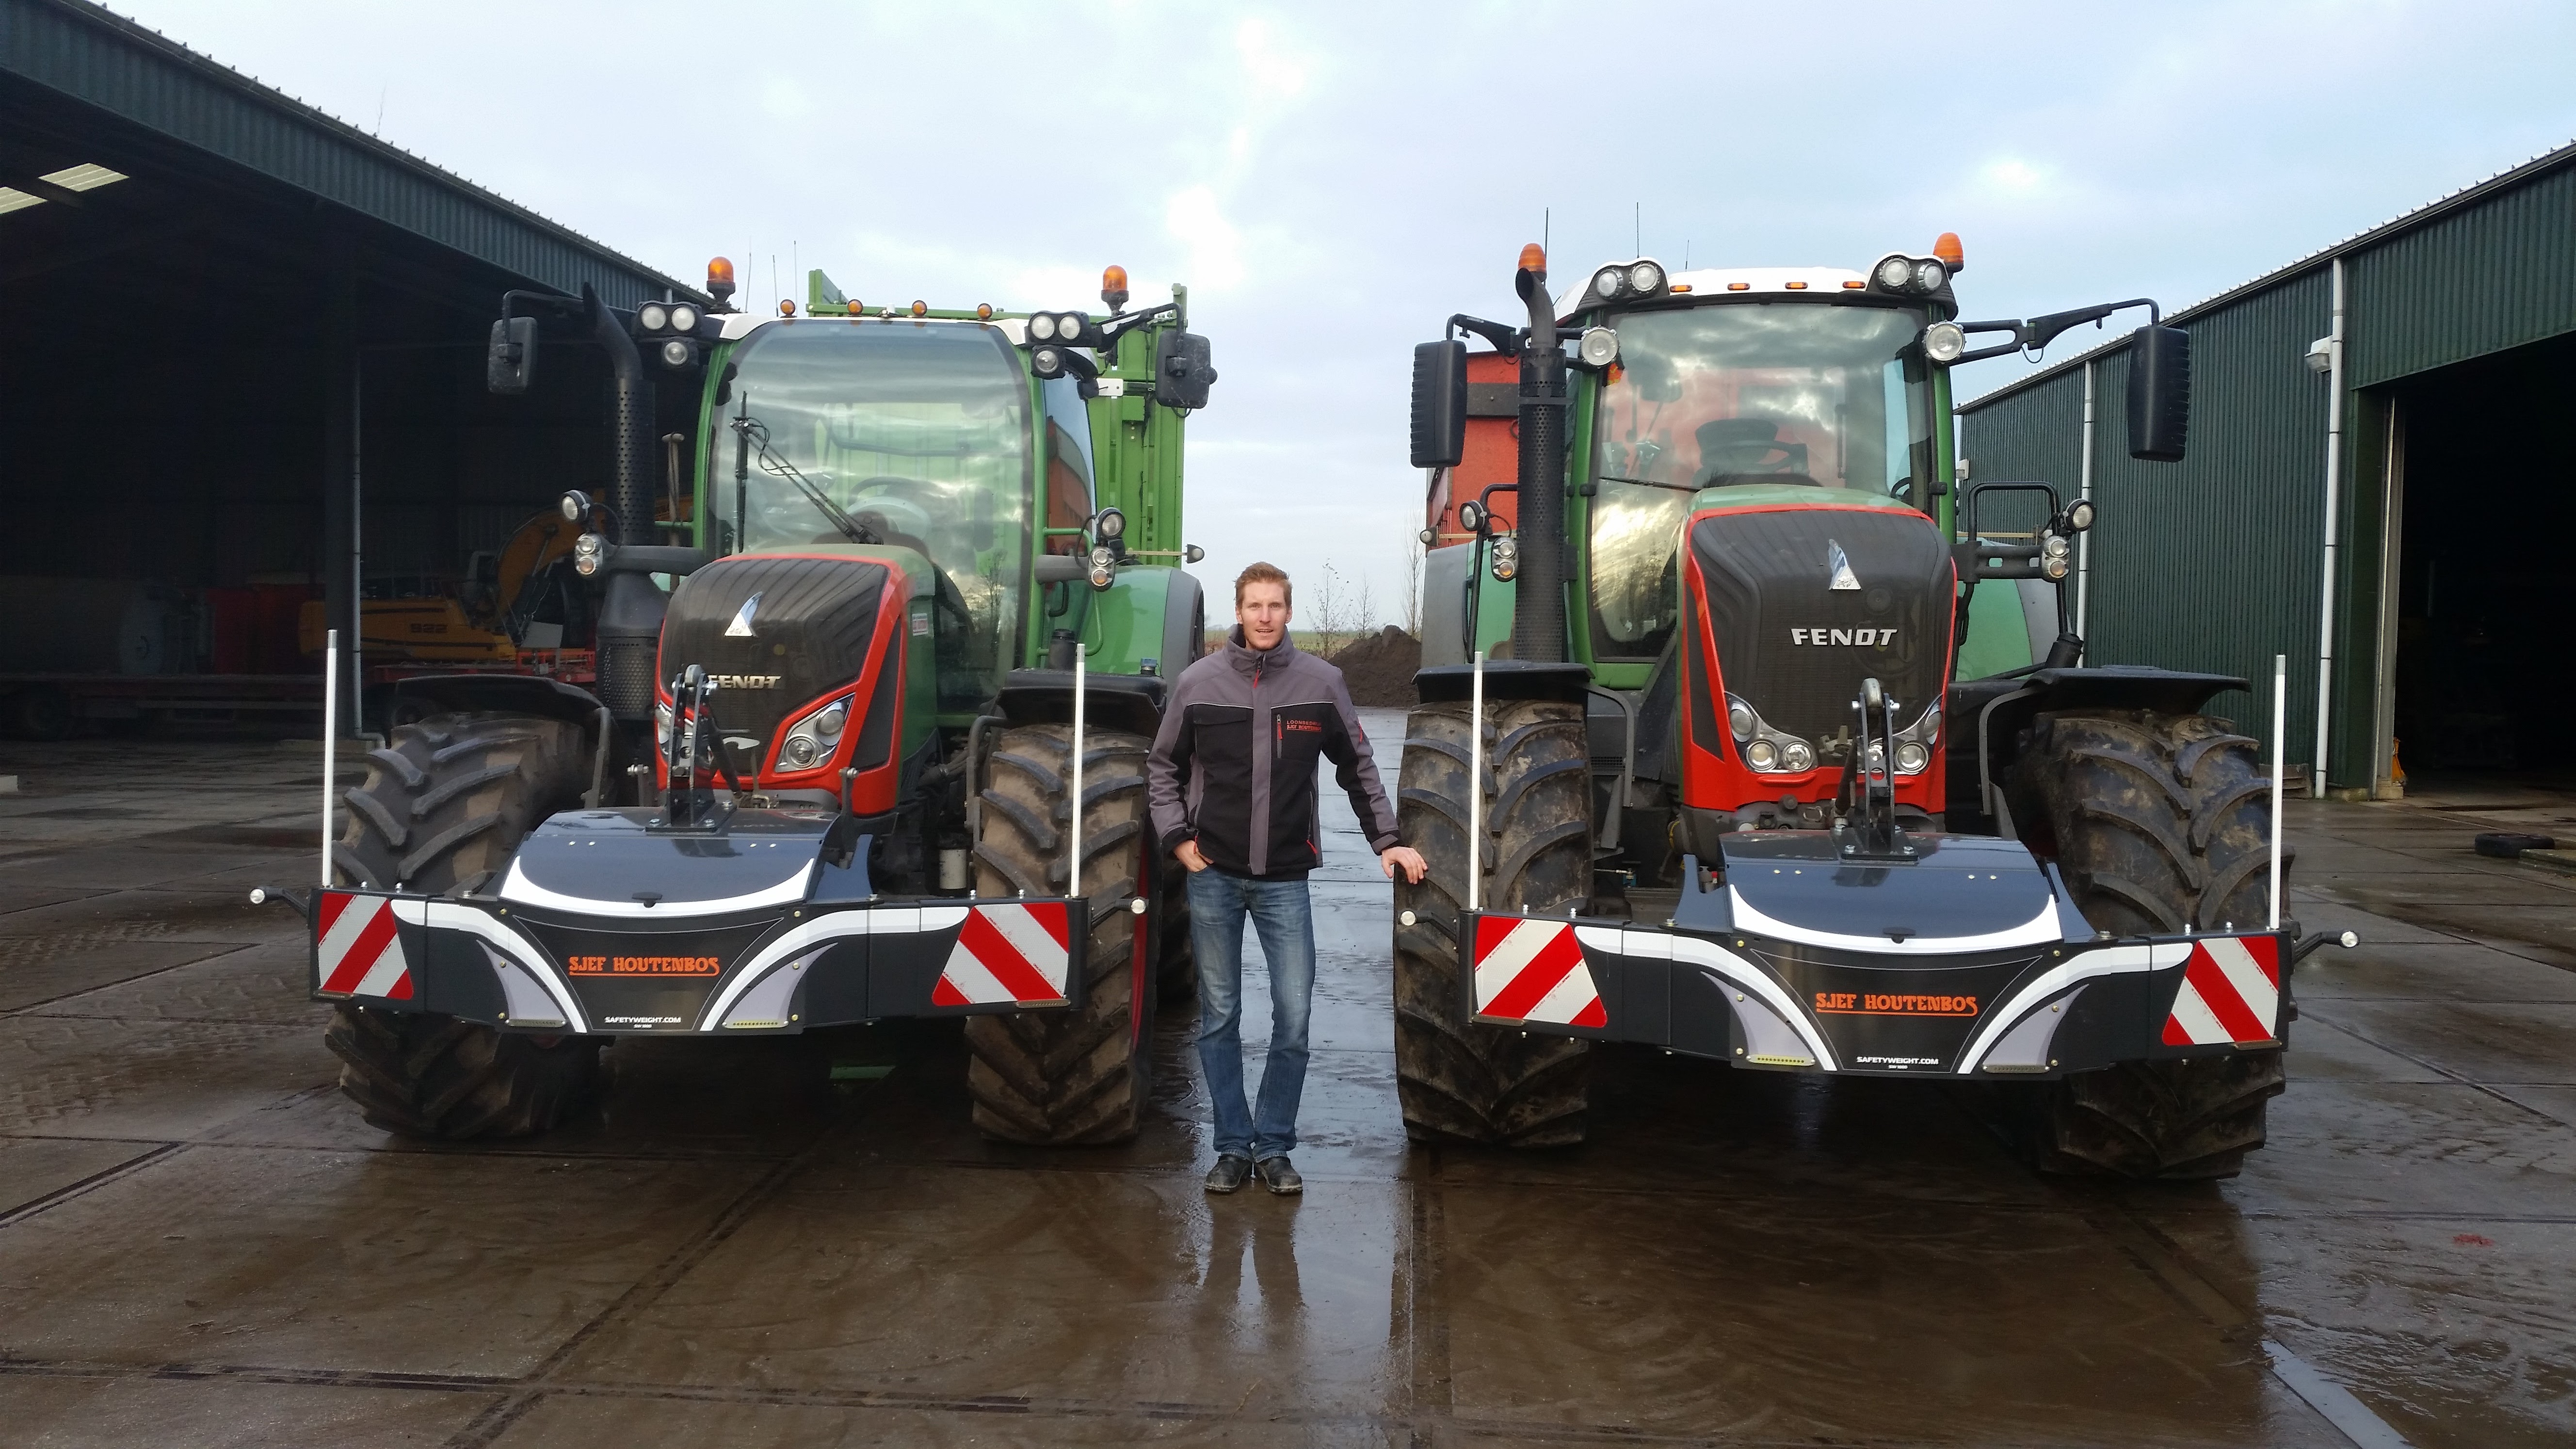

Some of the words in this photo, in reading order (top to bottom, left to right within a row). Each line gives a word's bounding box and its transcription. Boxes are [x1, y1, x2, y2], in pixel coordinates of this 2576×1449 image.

[1791, 628, 1898, 645] FENDT
[707, 675, 781, 689] FENDT
[569, 956, 606, 971] SJEF
[612, 956, 720, 975] HOUTENBOS
[1816, 993, 1856, 1009] SJEF
[1865, 994, 1978, 1015] HOUTENBOS
[1856, 1056, 1939, 1065] SAFETYWEIGHT.COM
